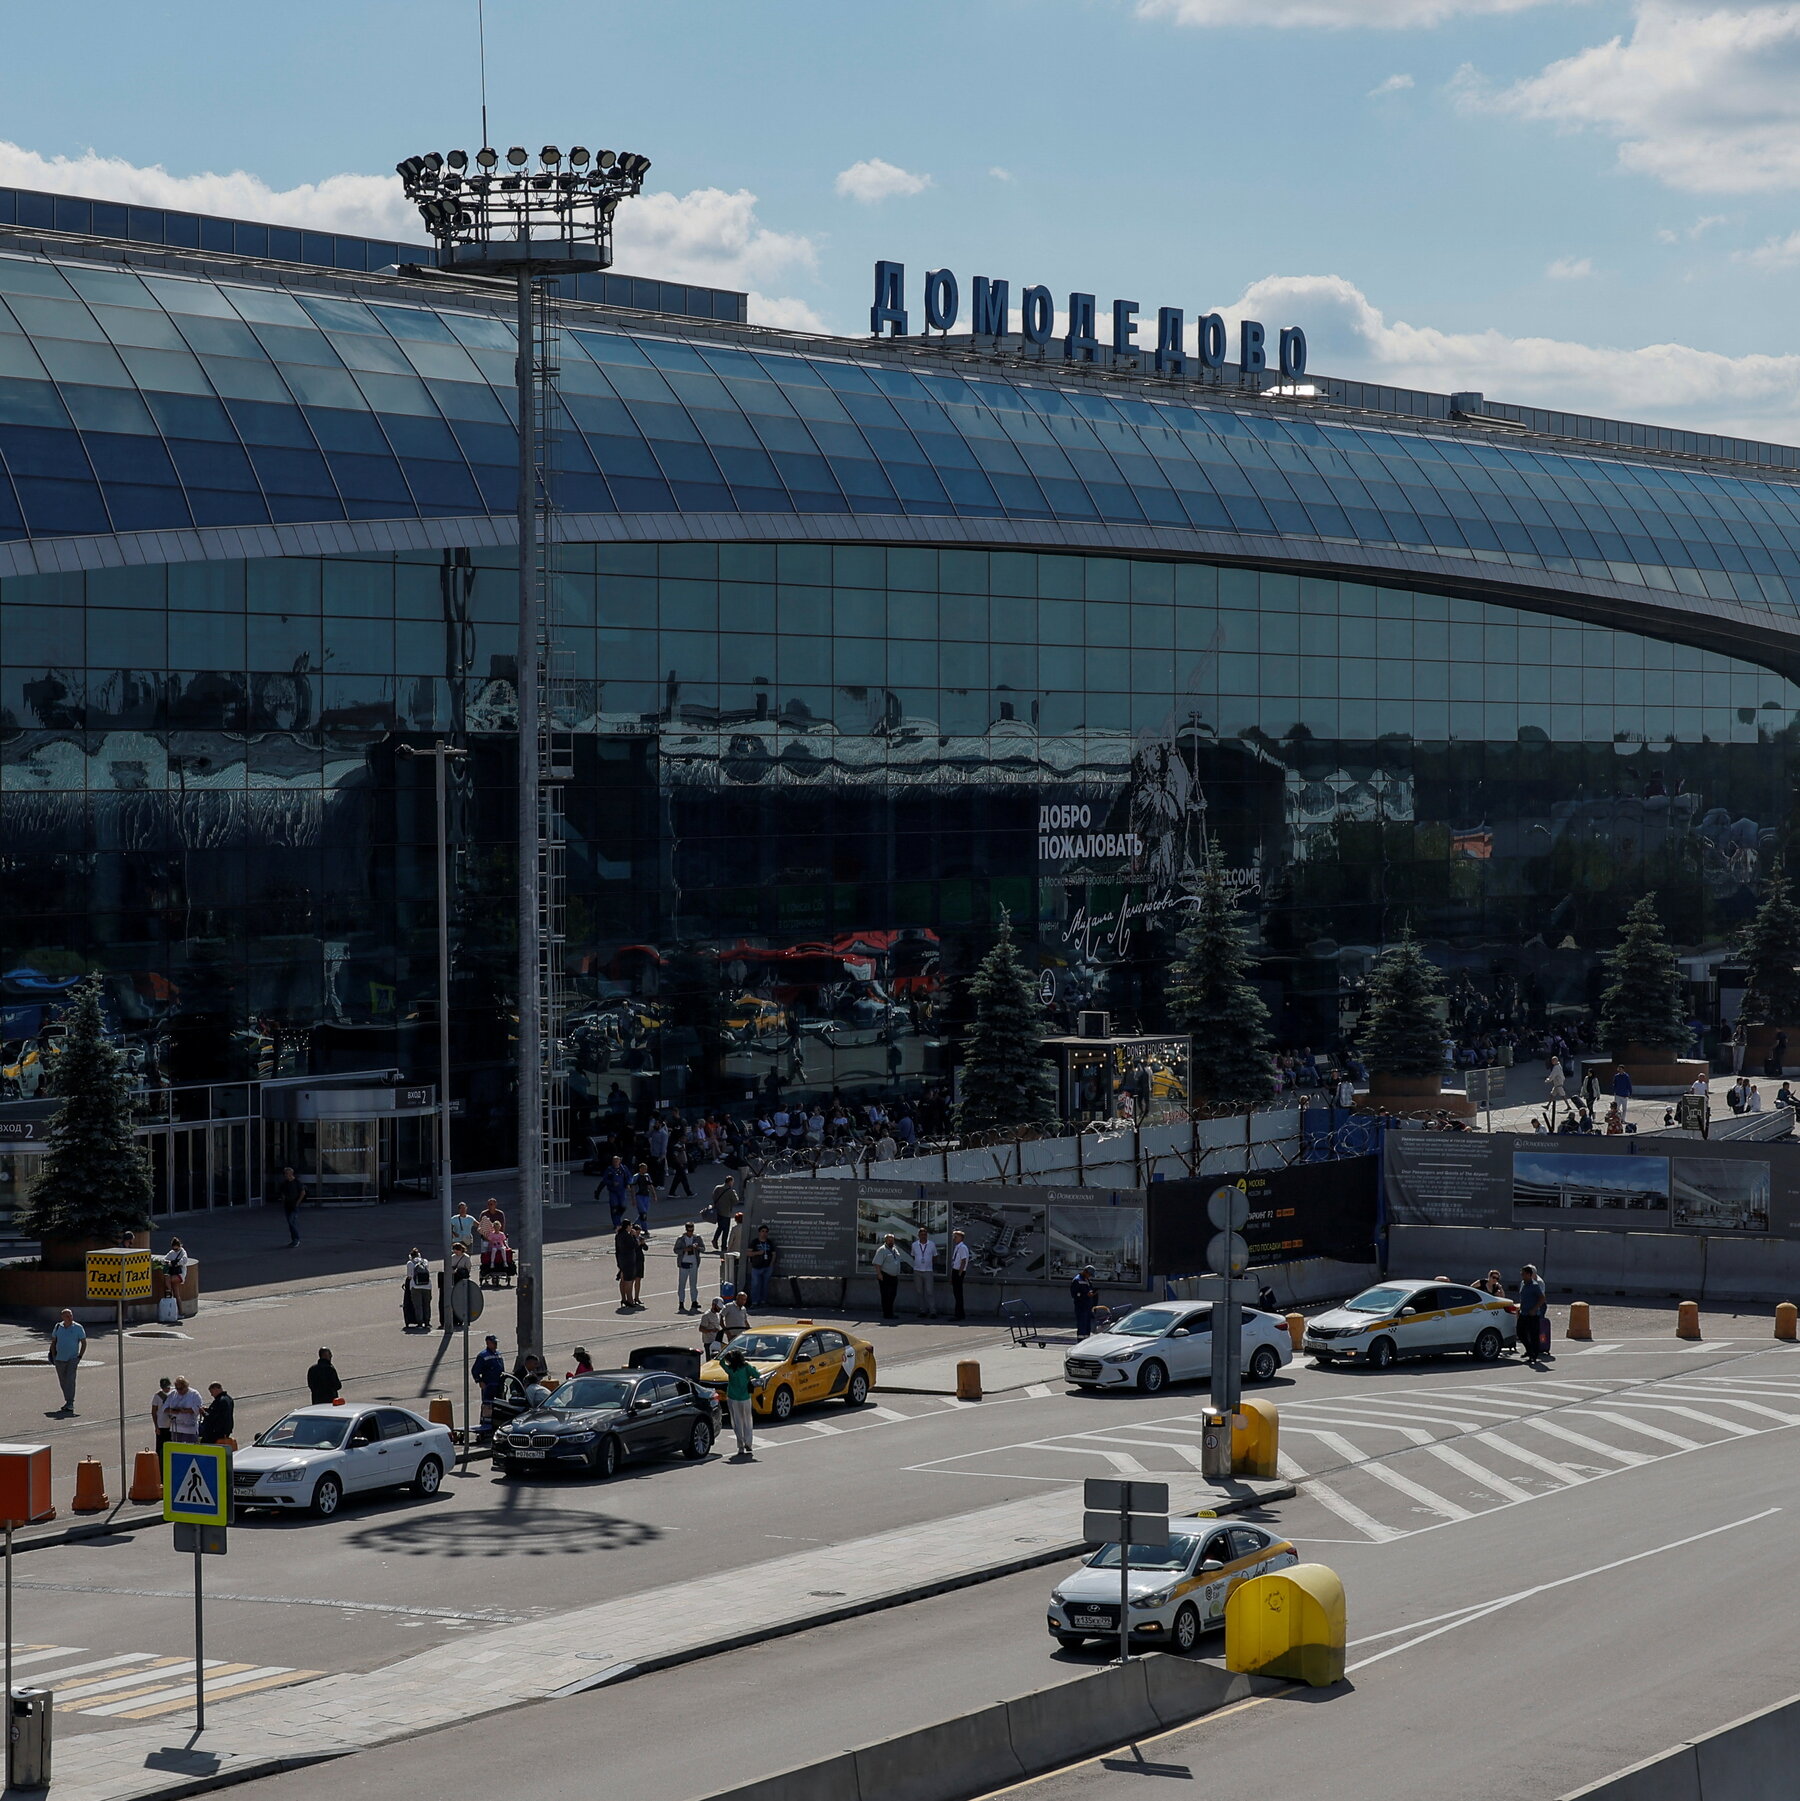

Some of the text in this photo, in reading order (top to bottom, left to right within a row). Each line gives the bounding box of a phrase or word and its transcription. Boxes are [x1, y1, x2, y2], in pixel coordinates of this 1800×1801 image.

[870, 260, 1307, 381] ДОМОДЕДОВО
[1039, 804, 1091, 833] ДОБРО
[1039, 834, 1143, 859] ПОЖАЛОВАТЬ
[421, 1090, 427, 1104] 2
[24, 1123, 34, 1139] 2
[89, 1270, 121, 1283] Taxi
[125, 1267, 150, 1283] Taxi
